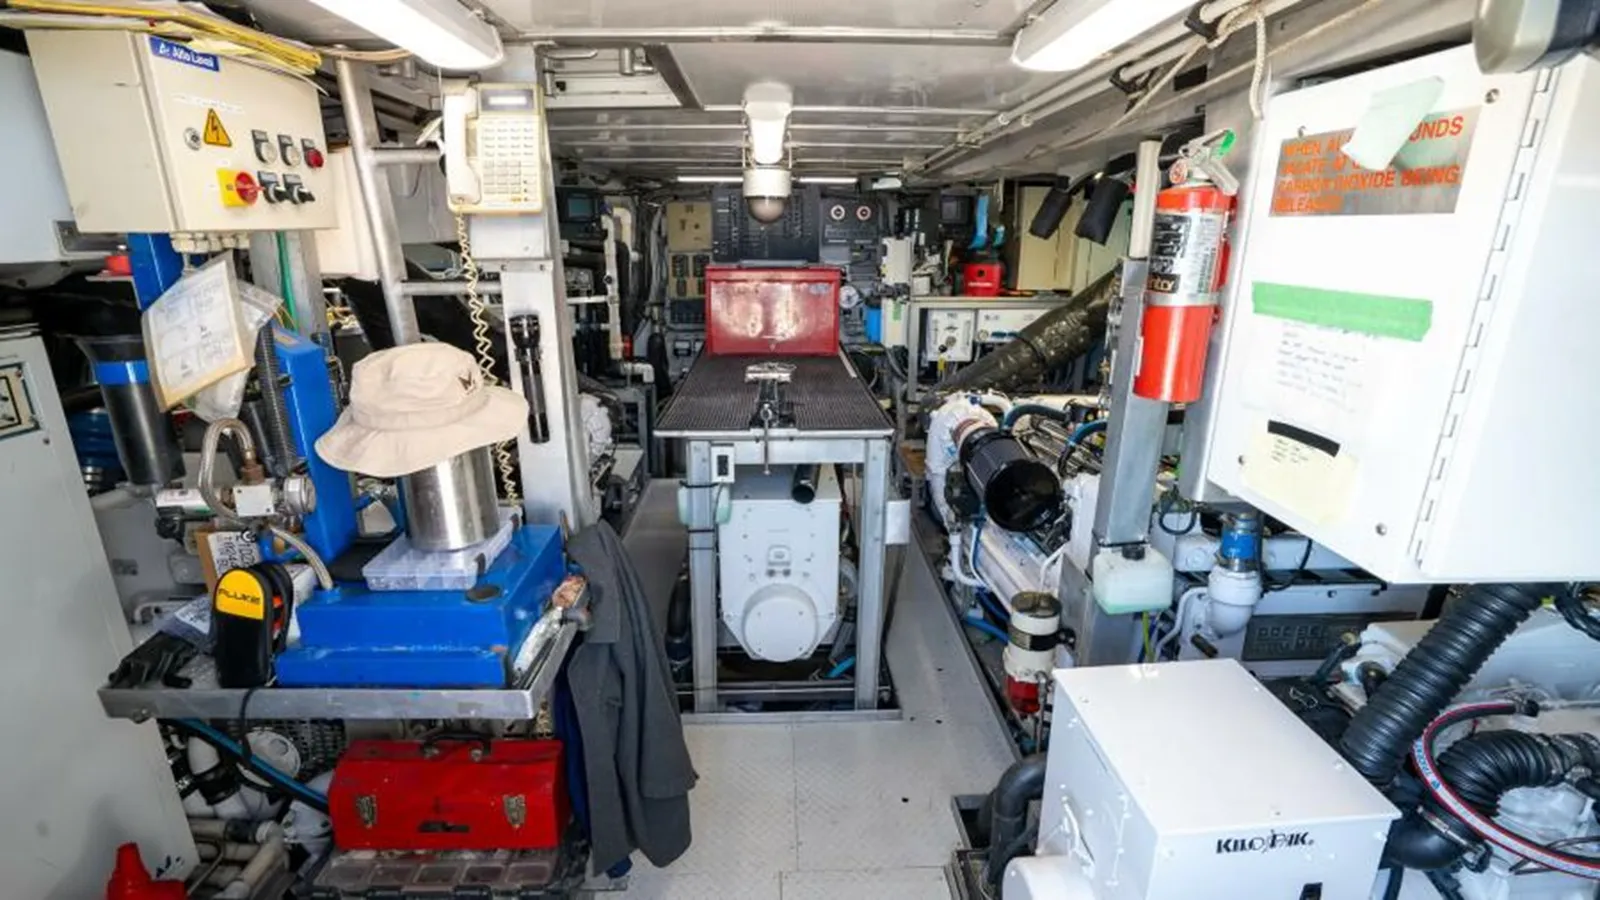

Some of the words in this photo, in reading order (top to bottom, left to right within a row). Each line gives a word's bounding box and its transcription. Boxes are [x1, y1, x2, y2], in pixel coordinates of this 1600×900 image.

[1283, 140, 1321, 157] WHEN
[1408, 115, 1464, 142] UNDS
[1401, 164, 1461, 187] BEING
[218, 588, 261, 606] FLUKE
